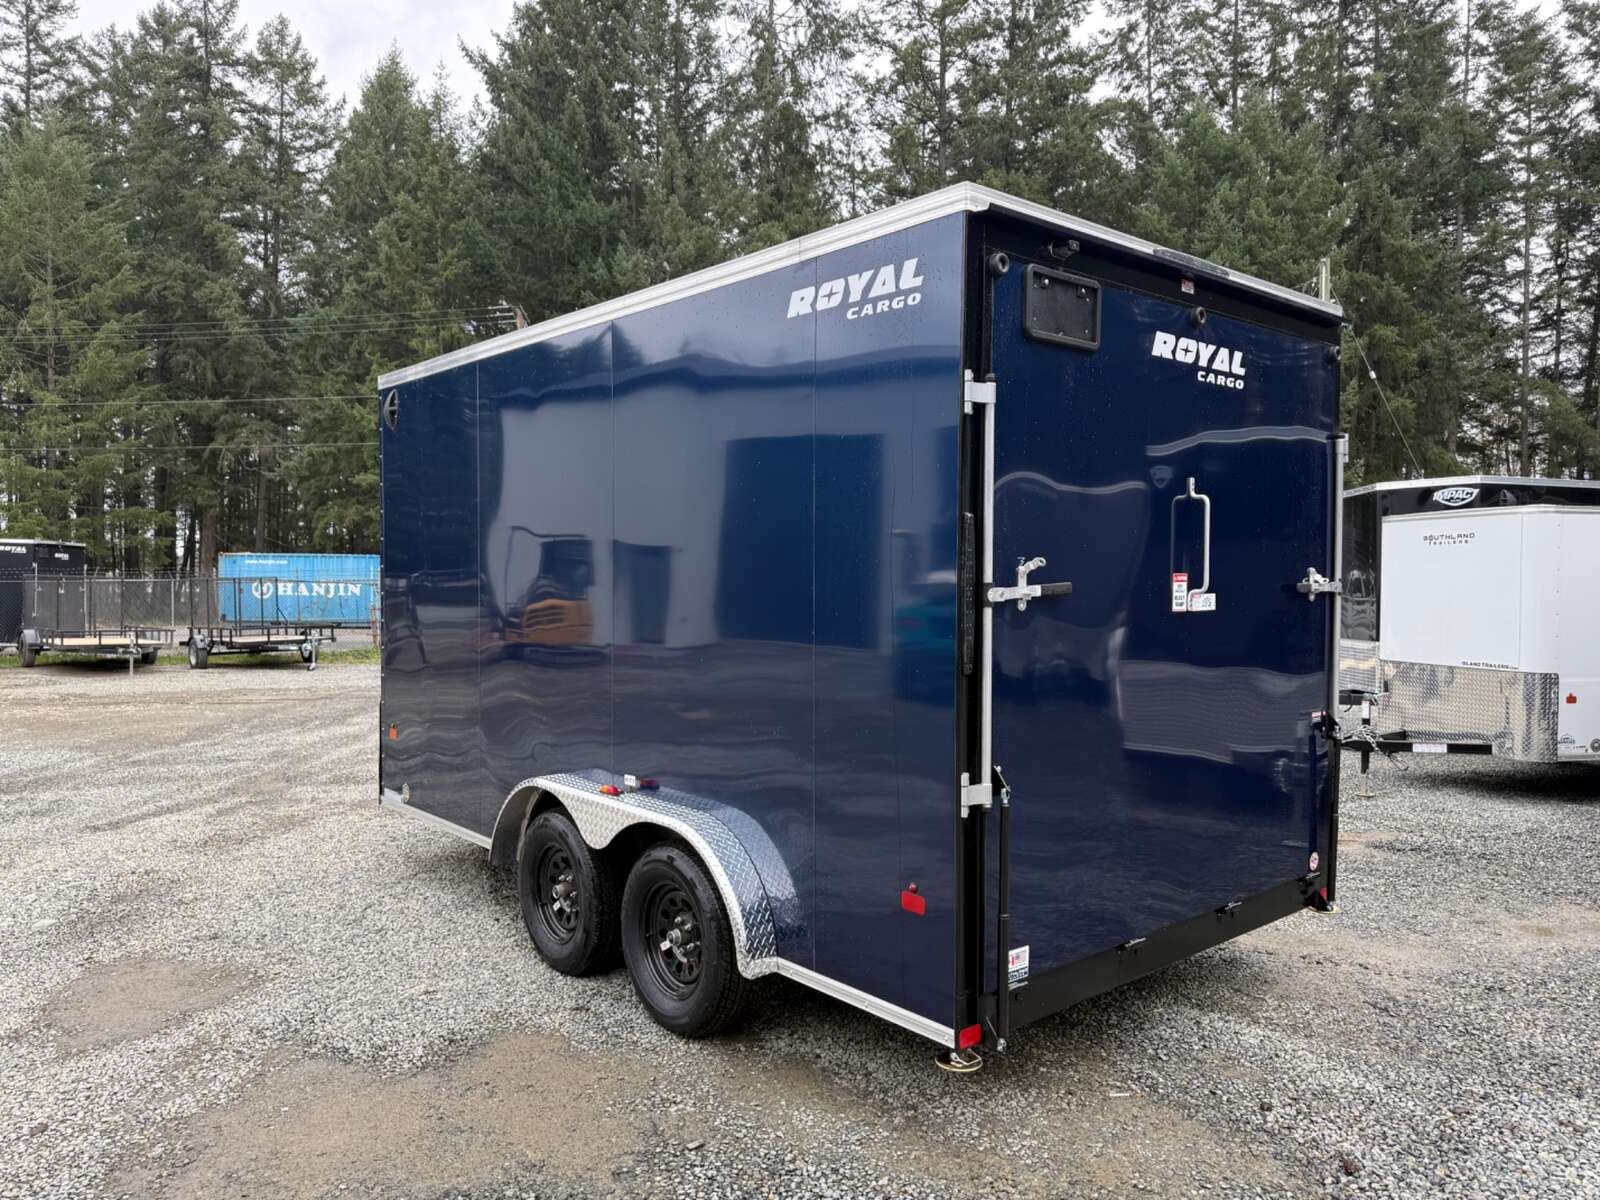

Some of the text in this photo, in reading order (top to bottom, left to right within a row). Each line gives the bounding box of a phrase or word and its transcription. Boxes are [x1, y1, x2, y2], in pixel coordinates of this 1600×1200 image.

[787, 258, 924, 319] ROYAL
[846, 292, 922, 320] CARGO
[1151, 330, 1246, 376] ROYAL
[1197, 370, 1244, 390] CARGO
[1423, 532, 1475, 541] SOUTHLAND
[276, 582, 362, 598] HANJIN
